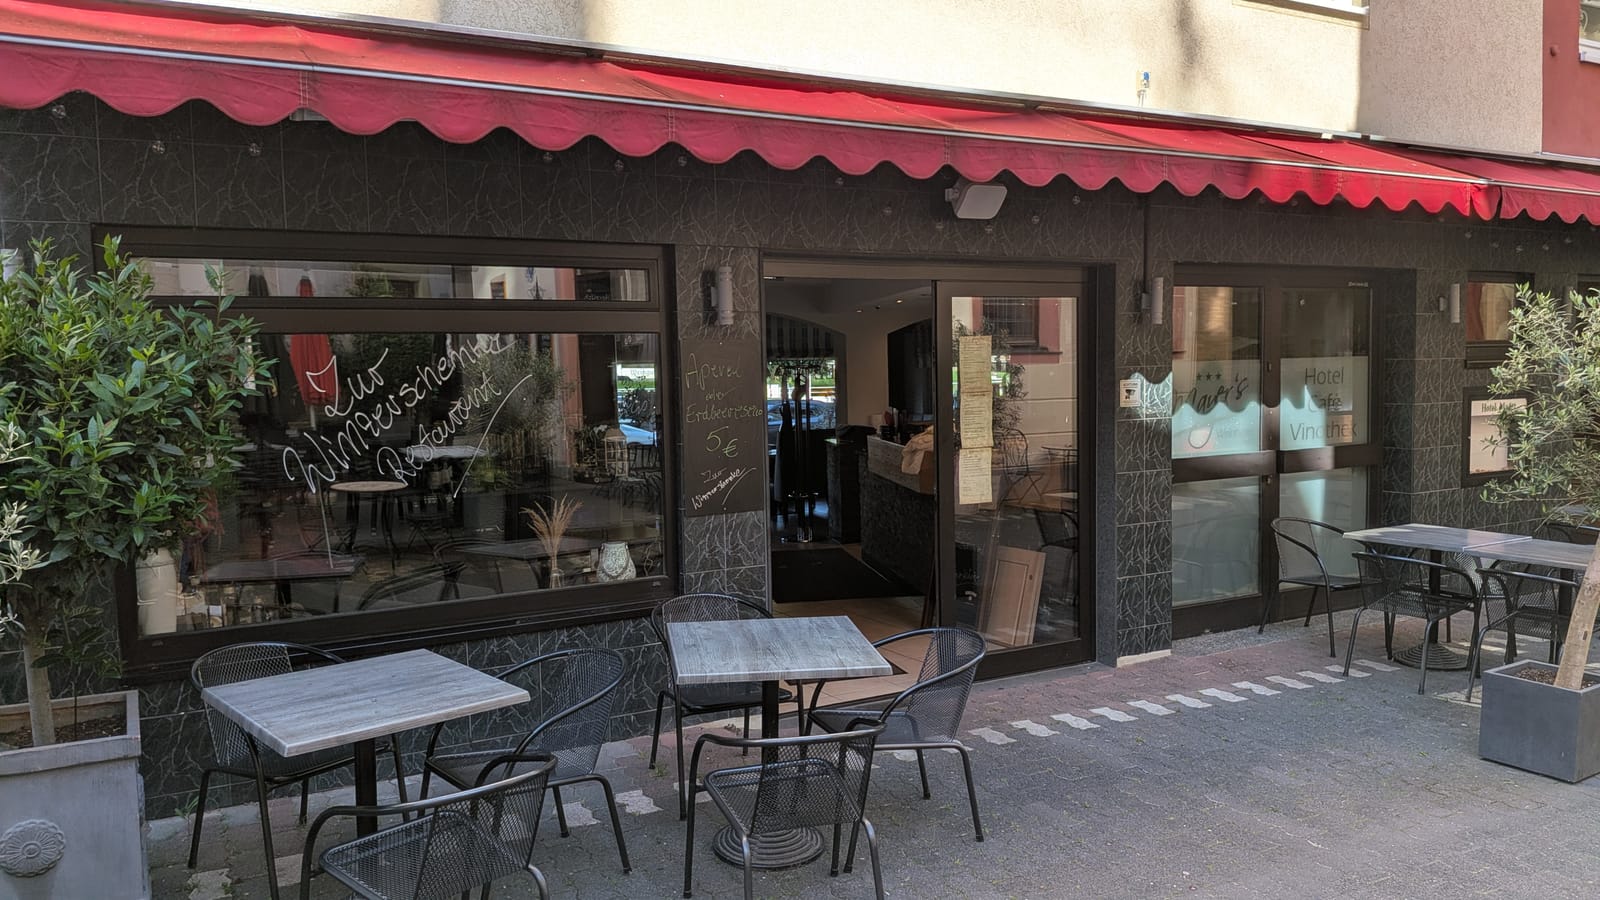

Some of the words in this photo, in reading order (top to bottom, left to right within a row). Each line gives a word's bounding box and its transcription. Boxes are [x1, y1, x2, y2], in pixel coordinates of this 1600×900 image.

[306, 347, 389, 417] Zur
[1304, 366, 1344, 385] Hotel
[282, 332, 518, 493] Winzerschenke
[1308, 393, 1343, 413] Café
[377, 371, 502, 486] Restaurant
[1289, 420, 1358, 441] Vinothek
